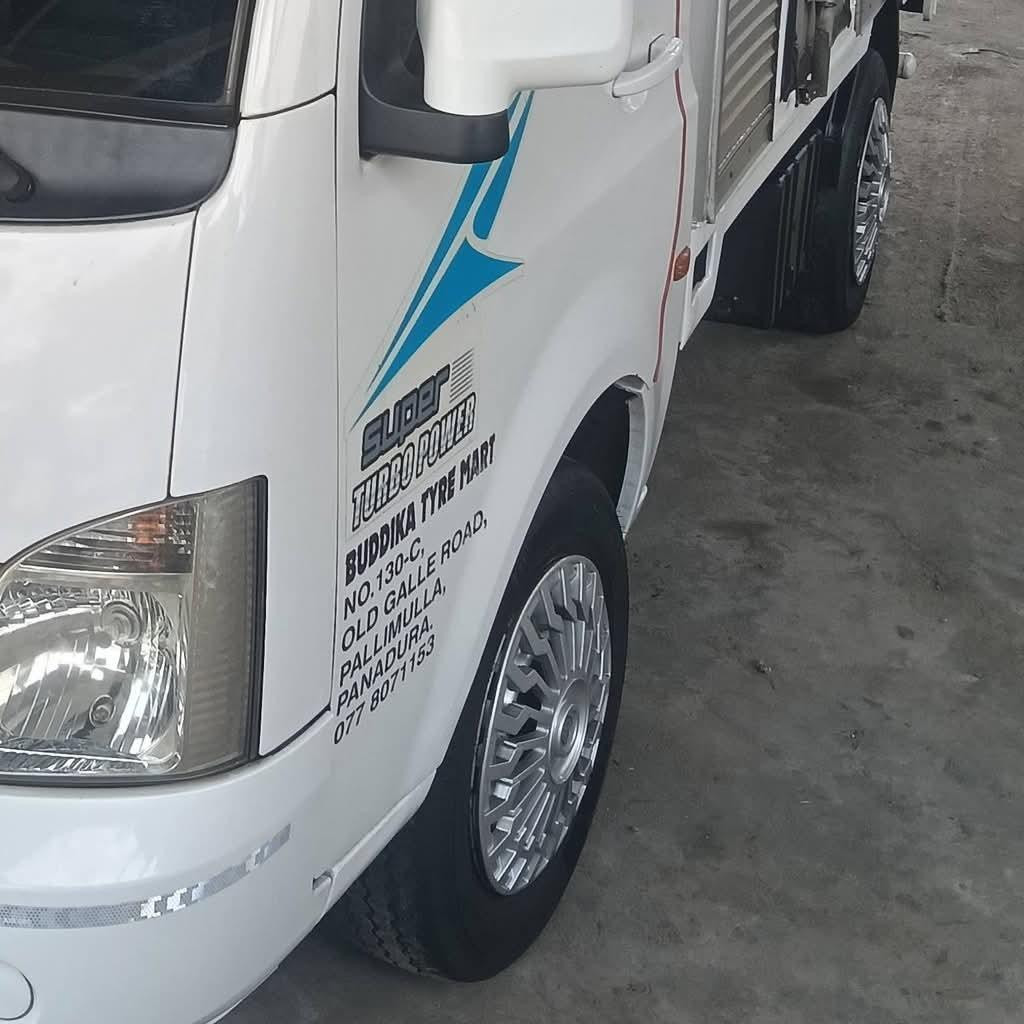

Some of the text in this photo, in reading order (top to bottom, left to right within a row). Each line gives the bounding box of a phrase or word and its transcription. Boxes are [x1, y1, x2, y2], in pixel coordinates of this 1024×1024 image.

[345, 433, 495, 587] BUDDIKA TYRE MART
[352, 392, 476, 532] TURBO POWER
[340, 577, 446, 687] PALLIMULLA,
[342, 510, 487, 652] OLD GALLE ROAD,
[334, 634, 435, 744] 077 8071153
